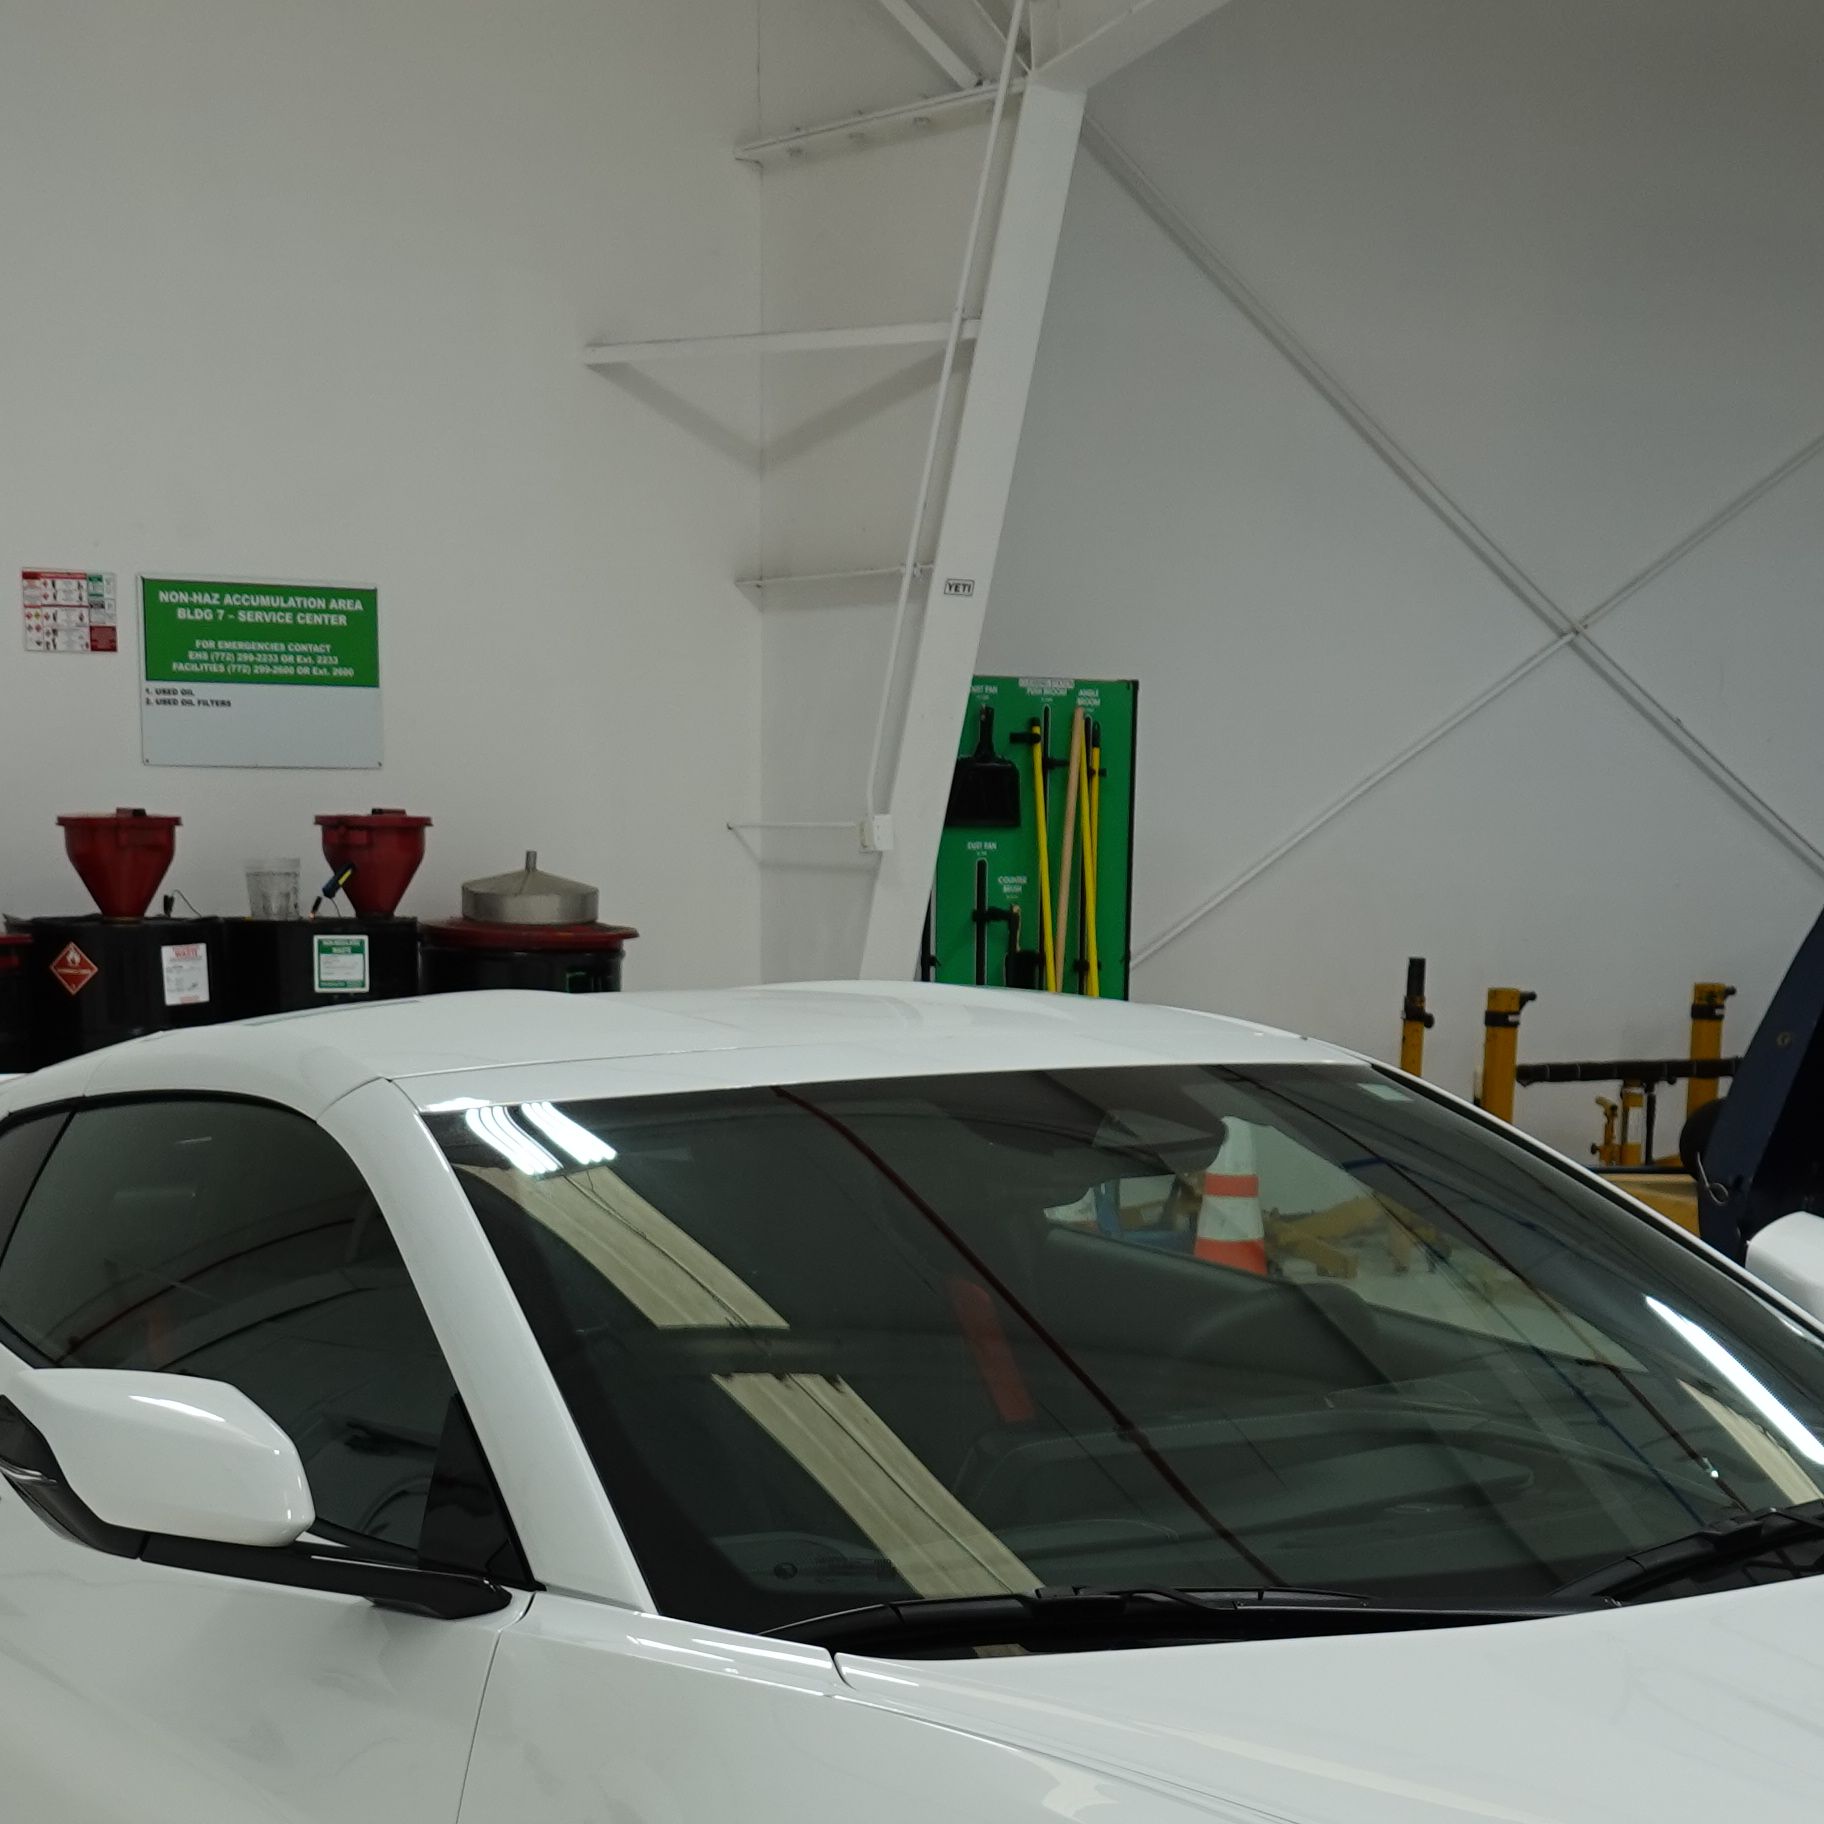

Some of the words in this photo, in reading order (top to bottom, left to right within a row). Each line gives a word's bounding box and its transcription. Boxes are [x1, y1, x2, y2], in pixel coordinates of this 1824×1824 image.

[947, 582, 972, 593] YETI
[159, 590, 221, 605] NON-HAZ
[223, 593, 326, 610] ACCUMULATION
[329, 598, 364, 611] AREA
[177, 607, 214, 621] BLDG
[216, 609, 225, 621] 7
[237, 610, 294, 624] SERVICE
[296, 612, 348, 626] CENTER
[195, 639, 216, 649] FOR
[217, 640, 286, 651] EMERGENCIES
[287, 643, 332, 653] CONTACT
[280, 654, 295, 663] OR
[172, 661, 225, 673] FACILITIES
[296, 666, 311, 675] OR
[155, 688, 178, 696] USED
[180, 688, 195, 696] OIL
[155, 698, 178, 706] USED
[180, 698, 195, 707] OIL
[197, 699, 232, 708] FILTERS
